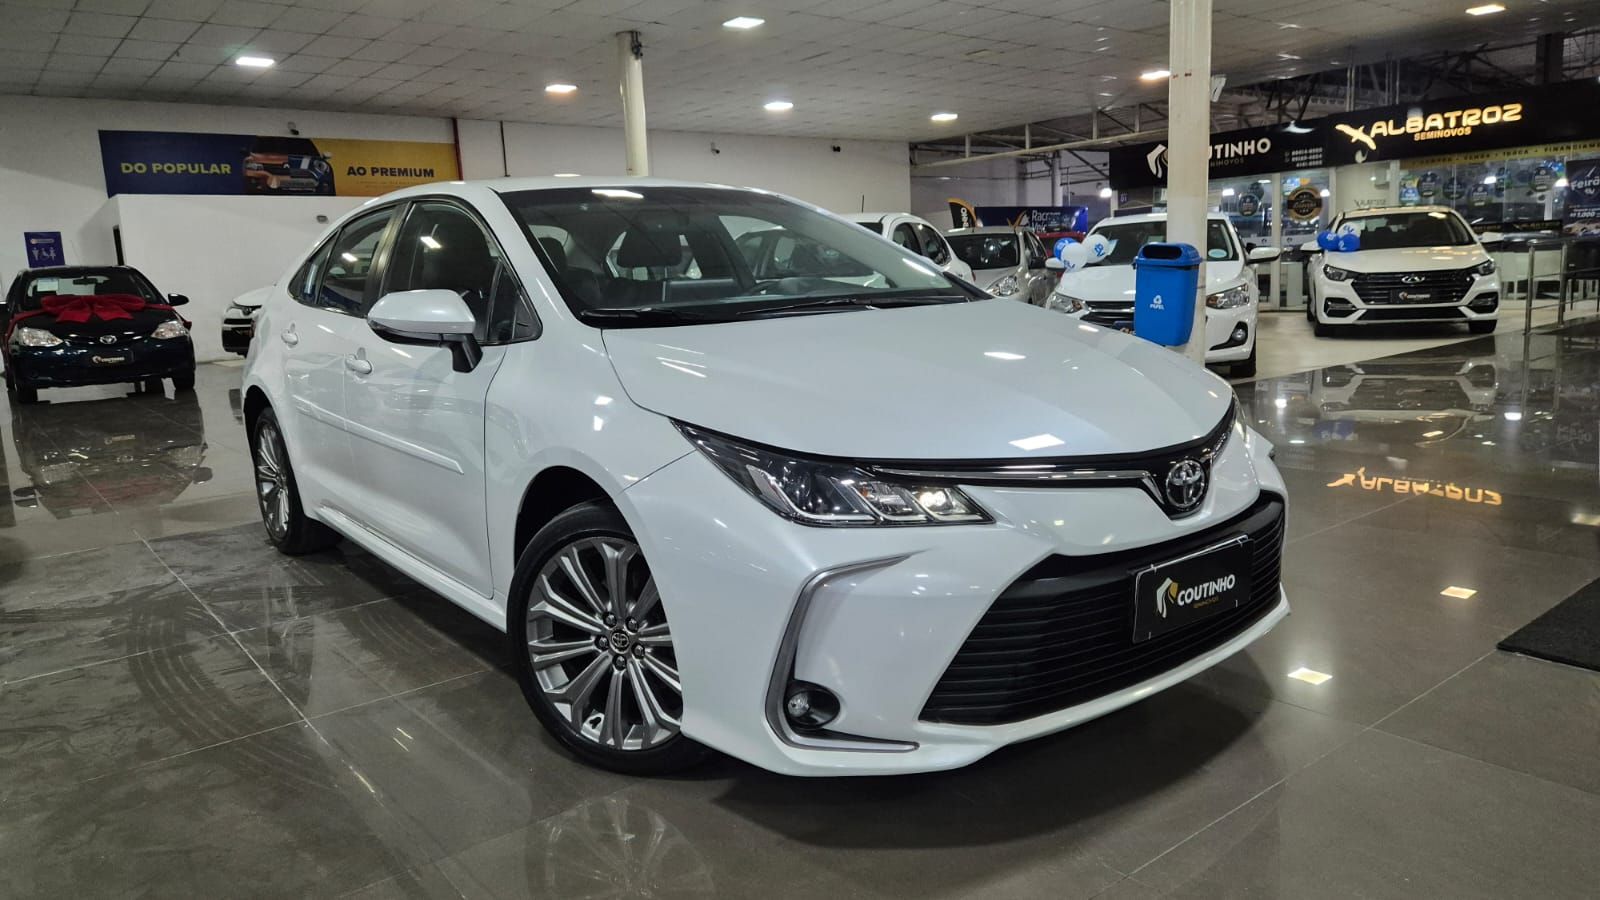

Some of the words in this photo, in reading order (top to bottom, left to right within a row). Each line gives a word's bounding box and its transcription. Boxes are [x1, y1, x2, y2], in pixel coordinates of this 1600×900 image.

[1370, 102, 1523, 138] ALBATROZ
[1413, 127, 1473, 141] SEMINOVOS
[120, 162, 147, 174] DO
[151, 162, 232, 175] POPULAR
[347, 166, 368, 176] AO
[371, 166, 436, 178] PREMIUM
[1177, 574, 1236, 606] COUTINHO
